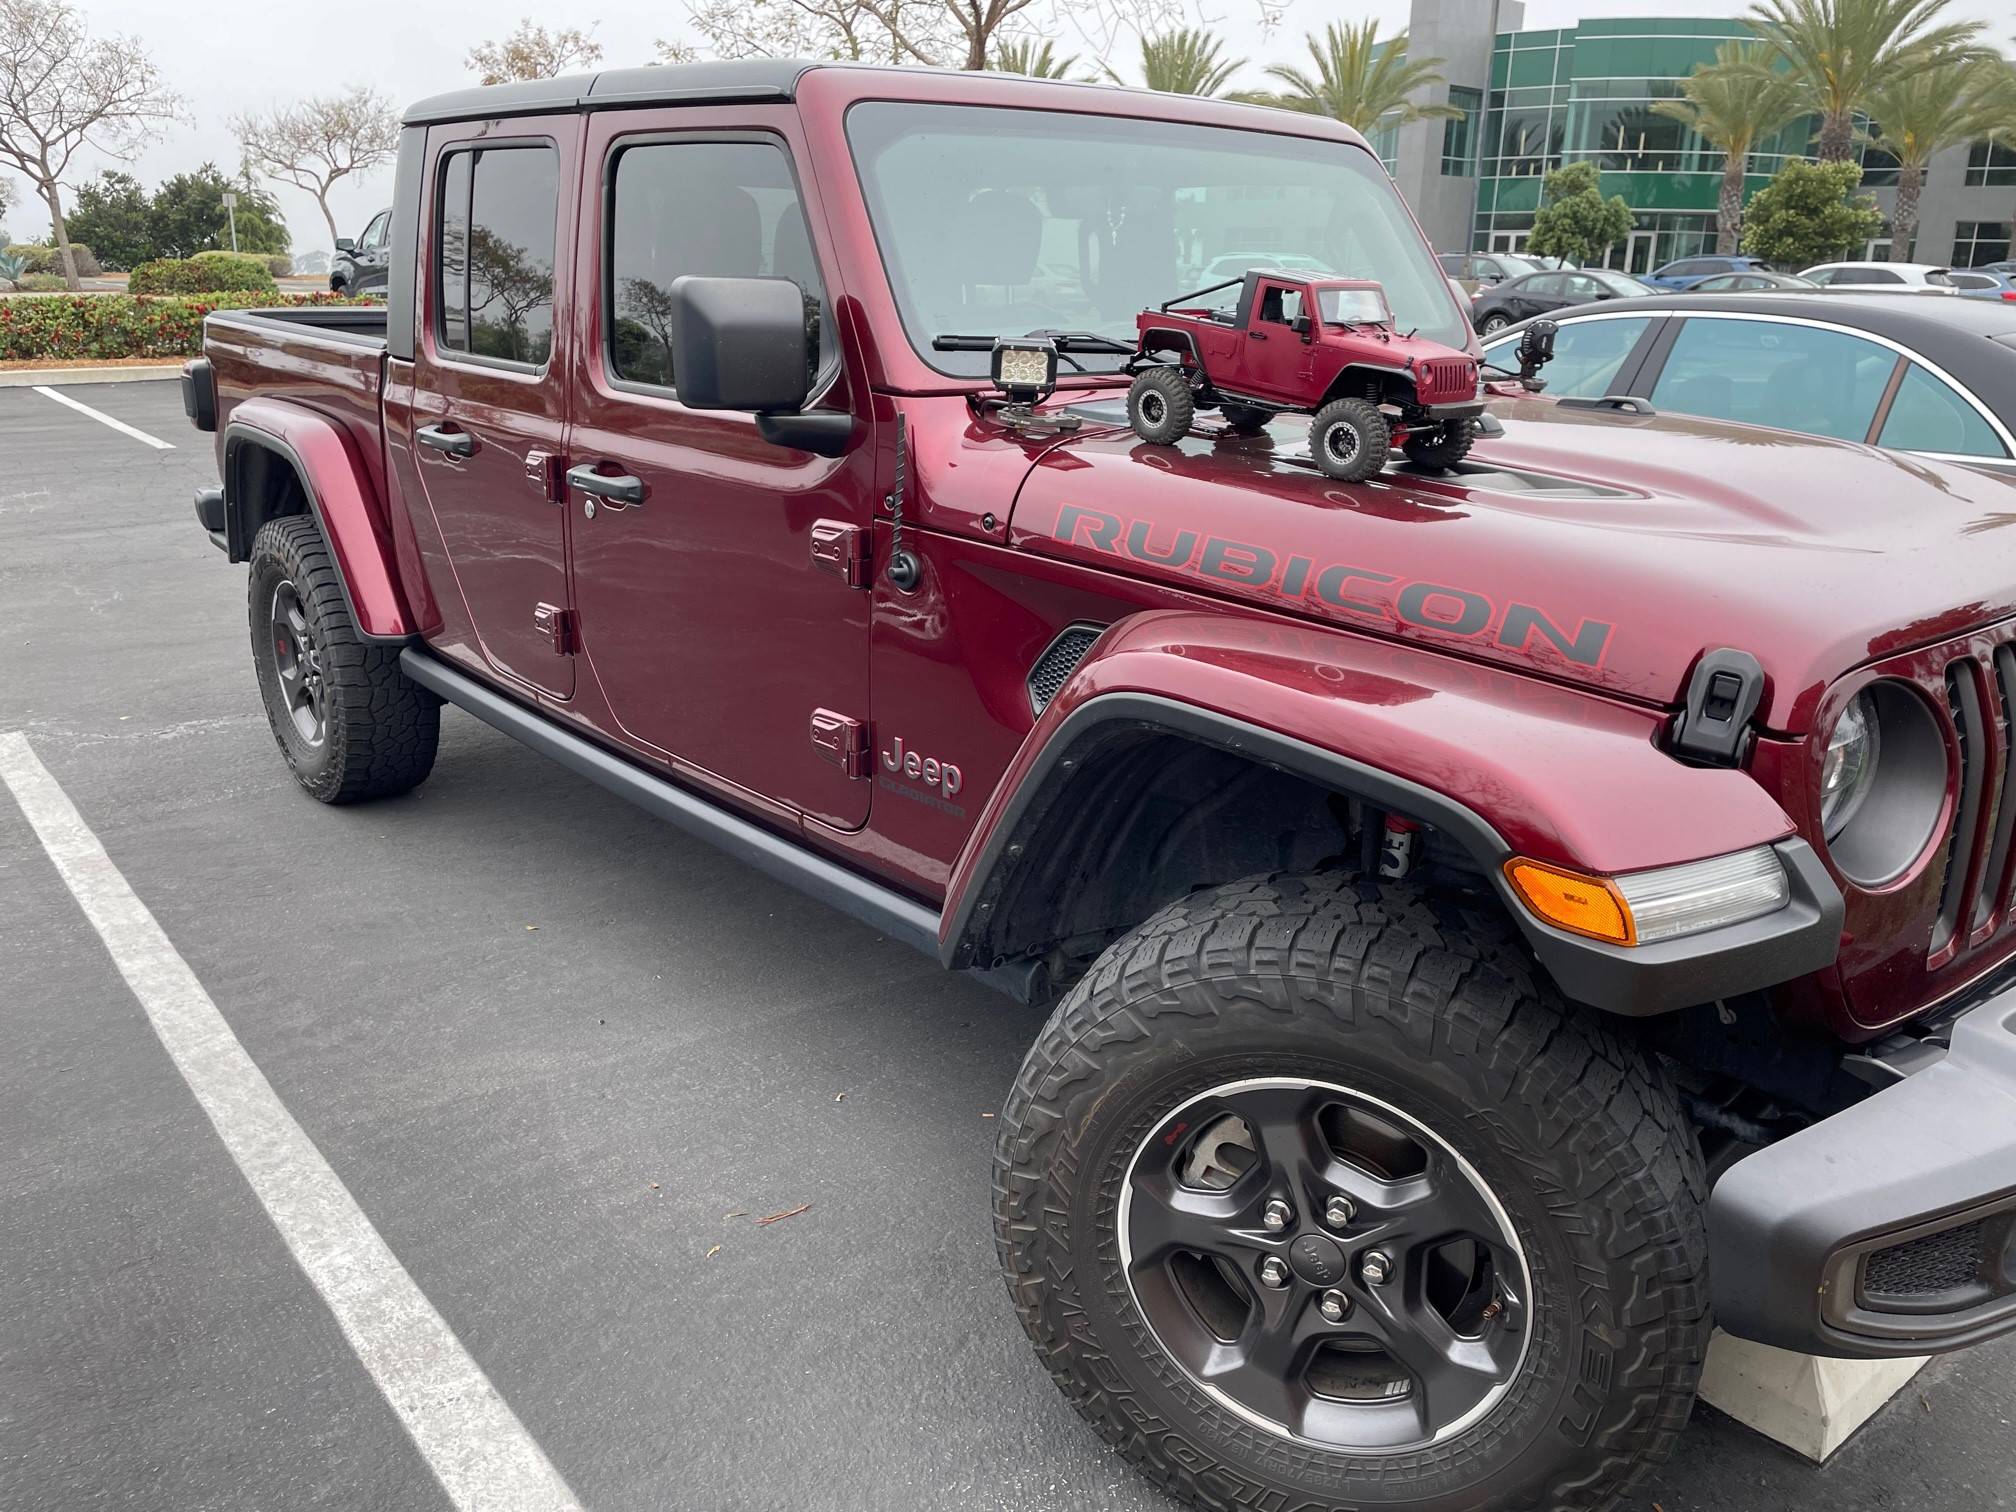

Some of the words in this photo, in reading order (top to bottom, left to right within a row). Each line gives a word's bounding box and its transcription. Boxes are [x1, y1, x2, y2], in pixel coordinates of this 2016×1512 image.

[1052, 501, 1618, 670] RUBICON
[882, 736, 962, 800] Jeep
[1303, 1241, 1332, 1279] Jeep
